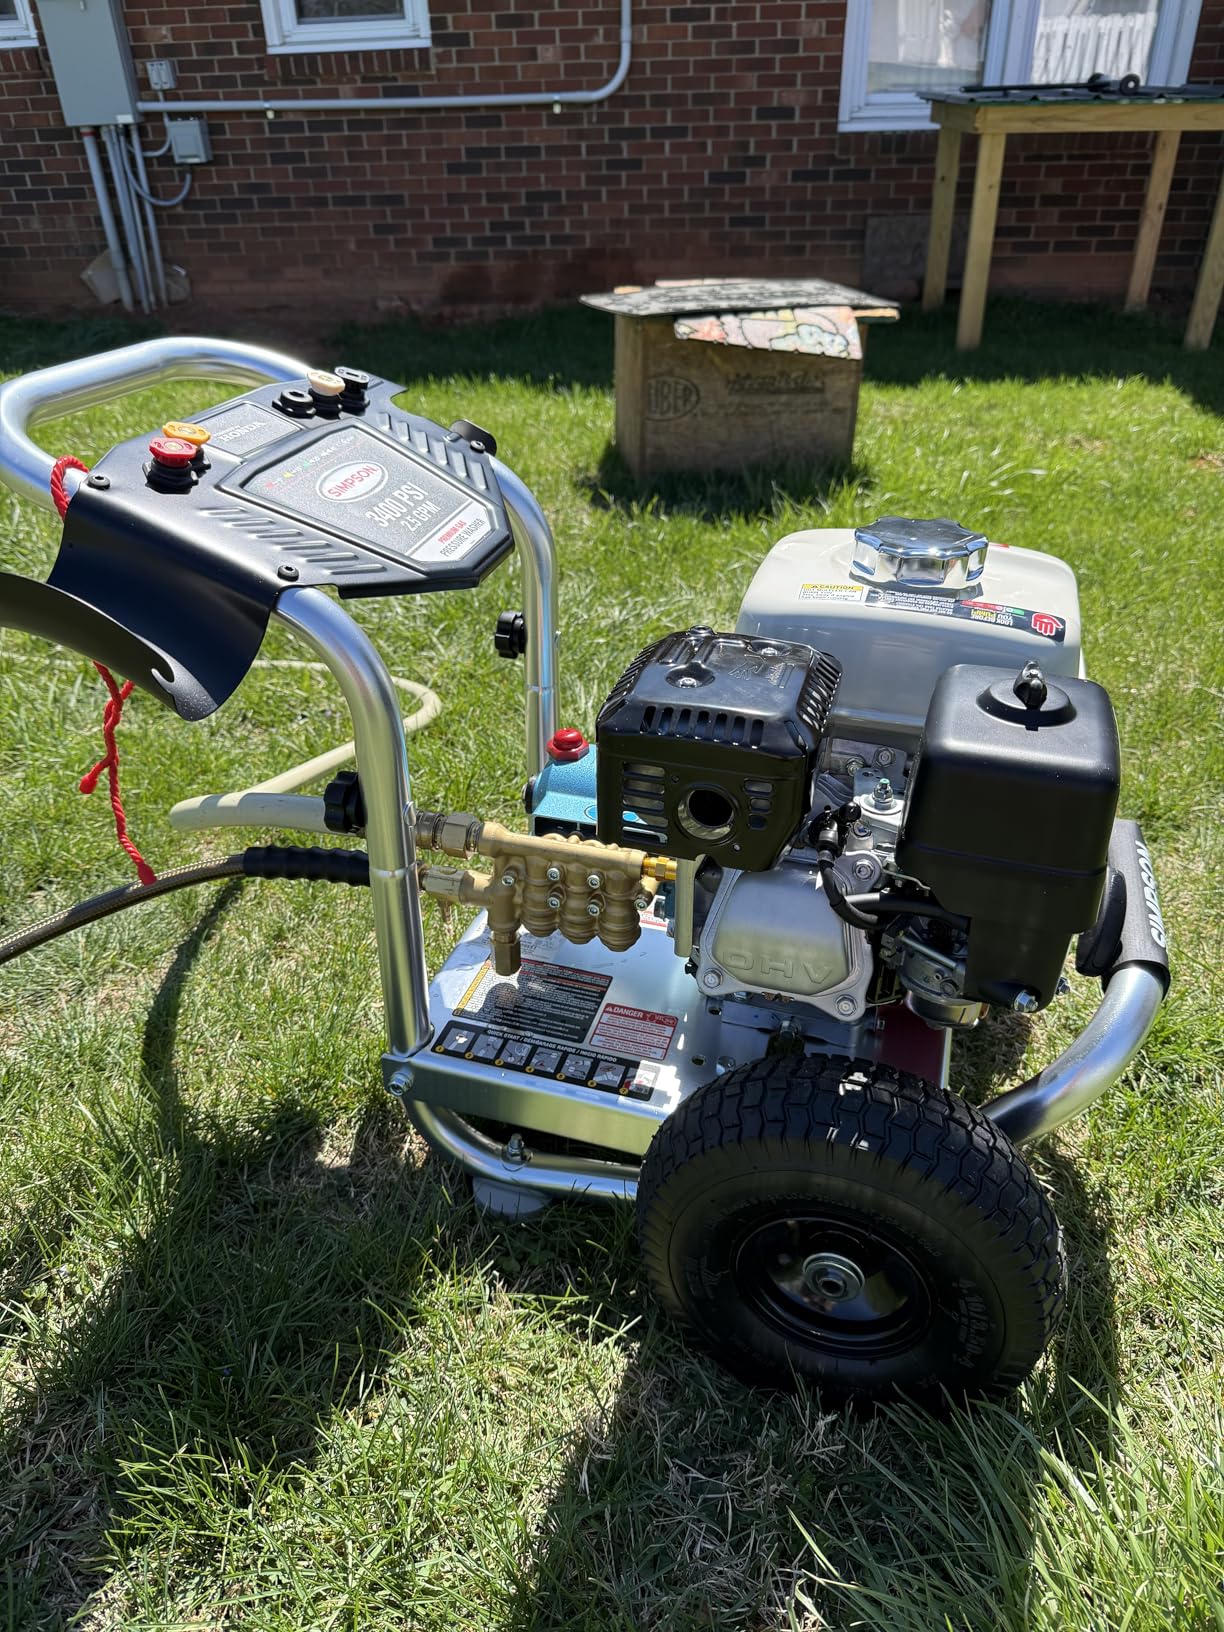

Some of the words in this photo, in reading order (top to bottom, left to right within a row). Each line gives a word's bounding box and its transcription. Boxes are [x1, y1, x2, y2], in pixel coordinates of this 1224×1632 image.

[218, 422, 266, 441] HONDA
[327, 465, 379, 498] SIMPSON
[365, 497, 407, 528] 3400
[392, 481, 429, 508] PSI
[412, 500, 441, 522] GPM
[440, 533, 469, 557] PRESSURE
[461, 518, 486, 537] WASHER
[996, 618, 1013, 626] LOOK
[722, 951, 833, 984] OHV
[613, 1007, 644, 1019] DANGER
[487, 1029, 503, 1037] QUICK
[503, 1032, 520, 1041] START
